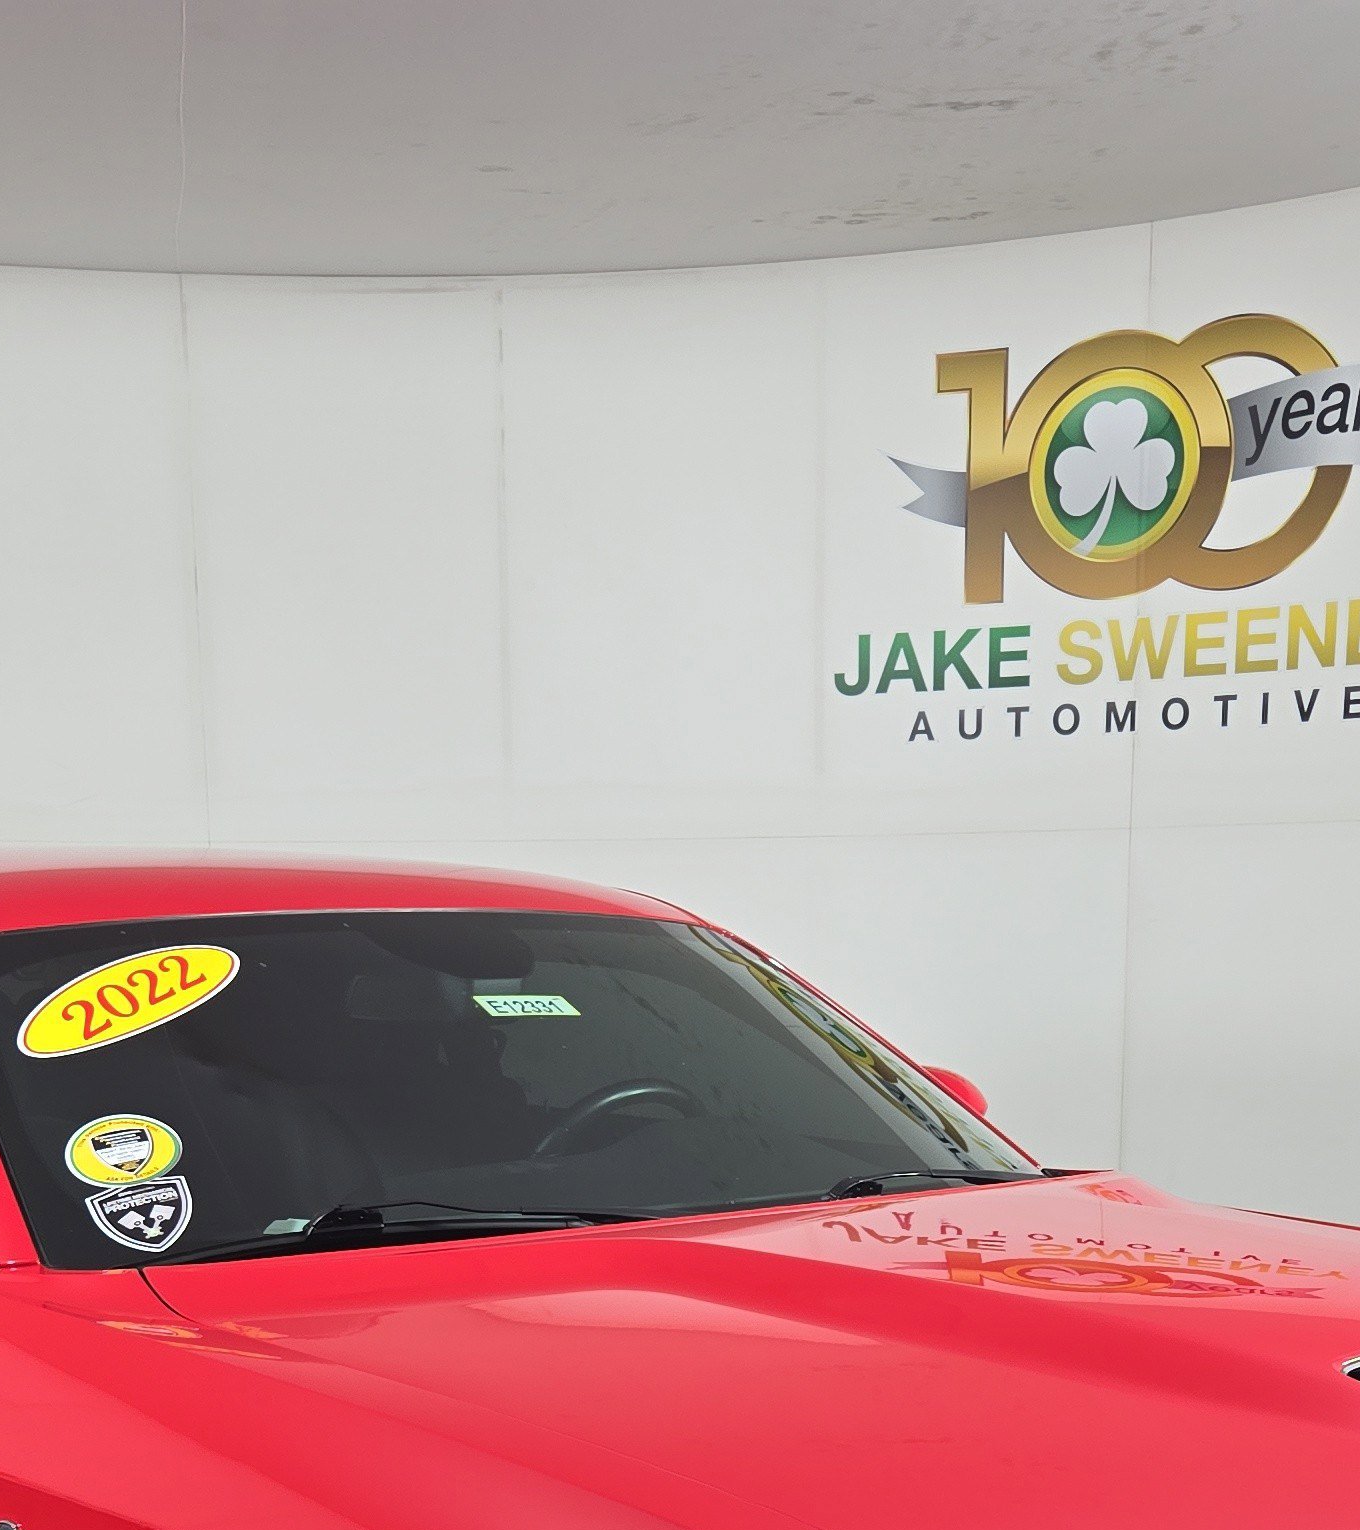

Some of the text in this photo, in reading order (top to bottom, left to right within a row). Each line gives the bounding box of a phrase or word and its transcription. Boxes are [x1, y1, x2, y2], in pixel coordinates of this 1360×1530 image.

[834, 626, 1031, 696] JAKE
[61, 956, 207, 1040] 2022
[486, 1000, 564, 1014] E12331
